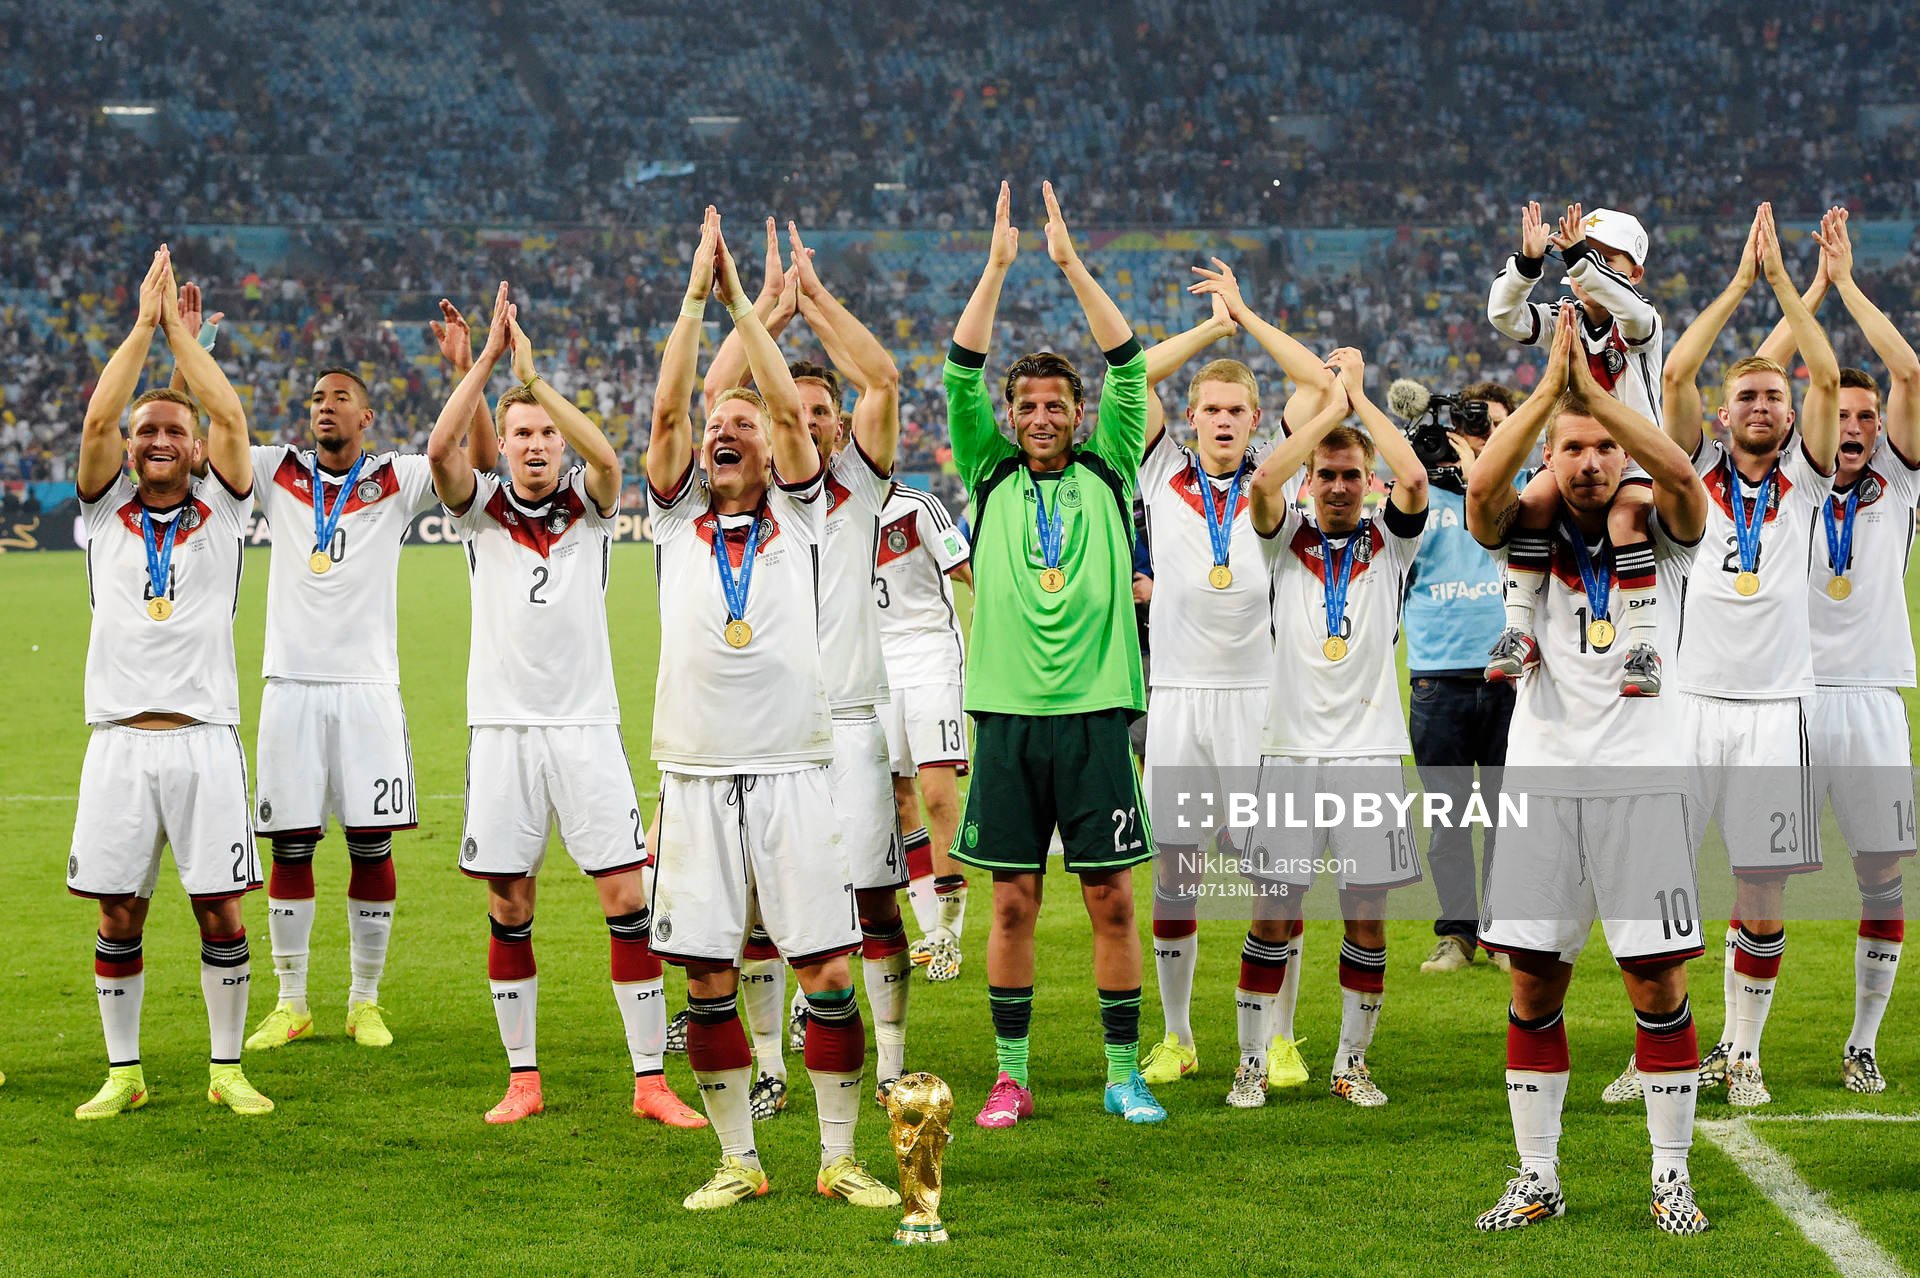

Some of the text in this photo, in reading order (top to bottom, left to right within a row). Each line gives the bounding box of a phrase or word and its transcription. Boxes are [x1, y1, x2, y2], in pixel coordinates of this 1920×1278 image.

[1424, 506, 1458, 531] FA
[312, 528, 346, 563] 0
[529, 566, 548, 604] 2
[1629, 597, 1657, 608] DFB
[938, 719, 961, 752] 13
[373, 777, 403, 816] 20
[630, 808, 646, 850] 2
[1111, 806, 1142, 853] 22
[1770, 811, 1798, 853] 23
[1893, 800, 1915, 842] 14
[230, 842, 247, 882] 2
[885, 832, 898, 875] 4
[1384, 828, 1409, 872] 16
[360, 910, 391, 918] DFB
[1654, 887, 1693, 941] 10
[1867, 951, 1897, 962] DFB
[741, 974, 775, 984] DFB
[1651, 1084, 1692, 1095] DFB
